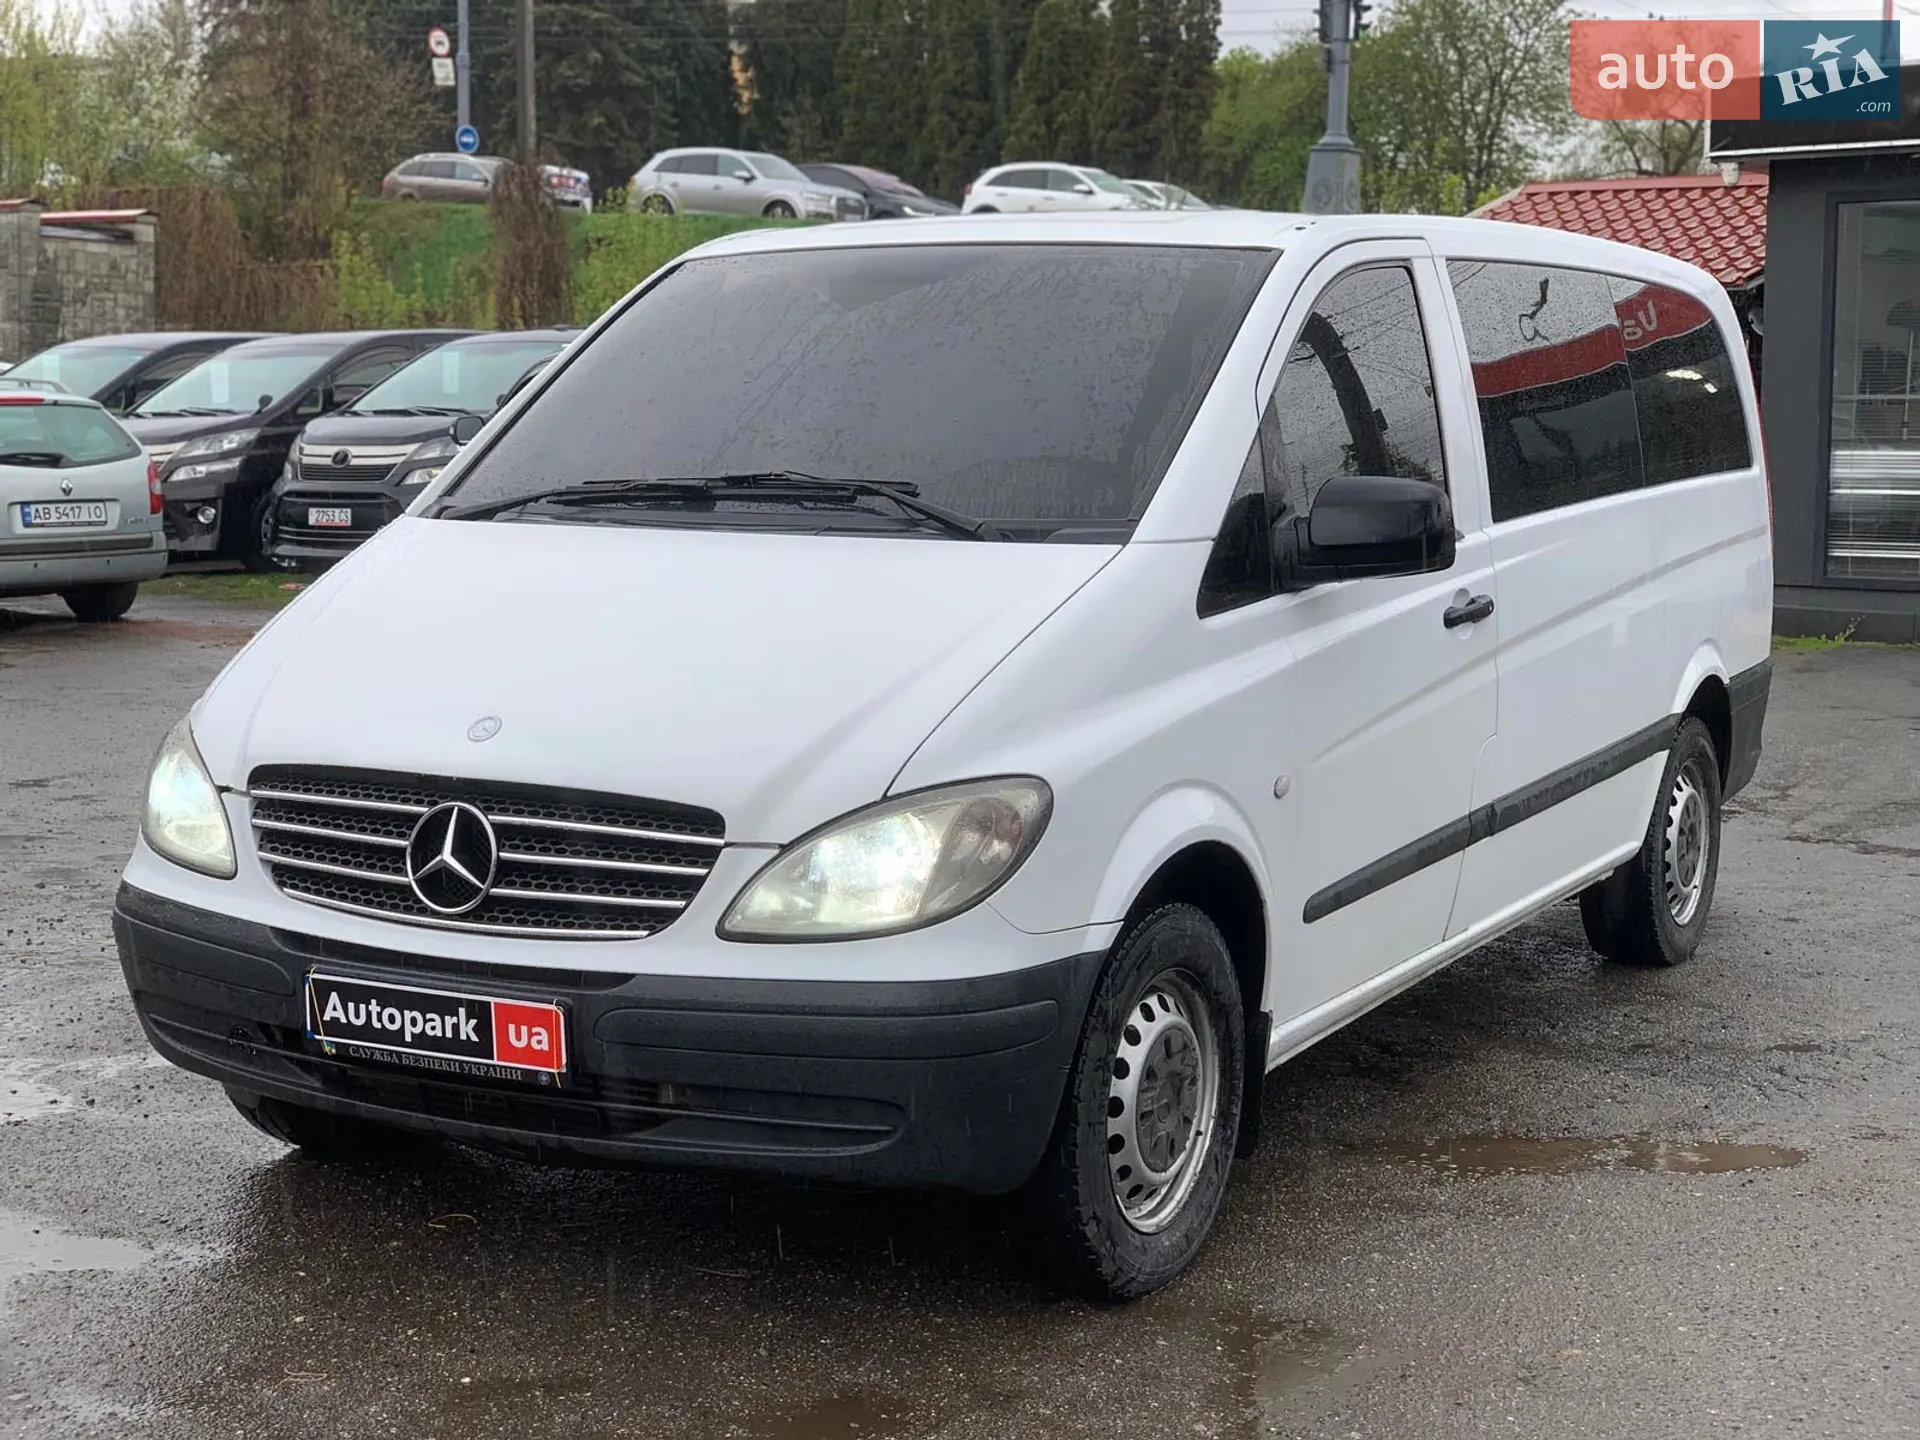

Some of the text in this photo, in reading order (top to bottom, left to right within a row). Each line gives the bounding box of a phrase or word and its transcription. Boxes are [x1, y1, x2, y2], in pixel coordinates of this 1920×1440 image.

[33, 507, 52, 521] AB
[54, 505, 82, 520] 5417
[322, 991, 550, 1052] Autopark ua
[349, 1045, 524, 1082] СЛУЖБА БЕЗПЕКИ УКРАЇНИ
